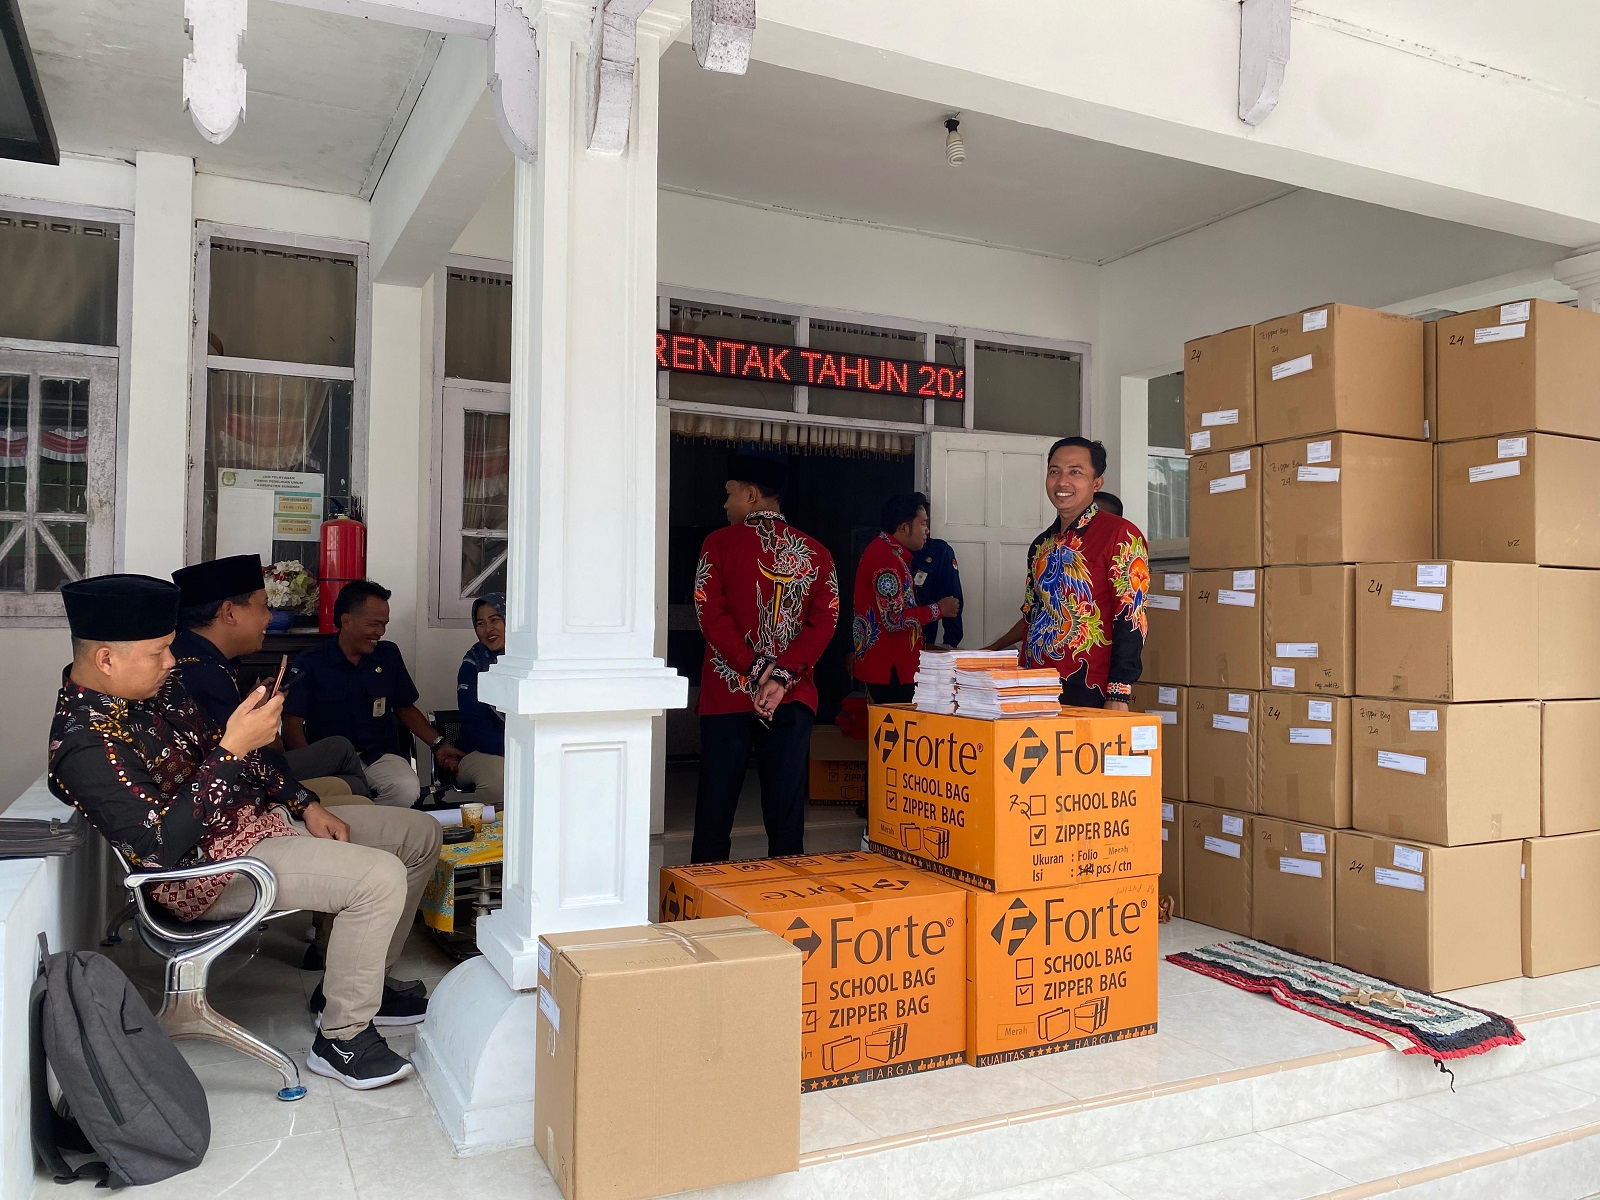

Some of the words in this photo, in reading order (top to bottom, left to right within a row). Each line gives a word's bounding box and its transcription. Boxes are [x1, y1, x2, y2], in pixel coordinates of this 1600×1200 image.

[1449, 334, 1465, 346] 24
[800, 352, 907, 393] TAHUN
[1198, 590, 1211, 603] 24
[1367, 580, 1383, 596] 24
[1268, 706, 1281, 720] 24
[1055, 730, 1149, 777] Fort
[844, 762, 866, 771] SCHO
[844, 774, 866, 782] ZIPPE
[902, 773, 943, 798] SCHOOL
[946, 783, 970, 803] BAG
[1055, 792, 1108, 813] SCHOOL
[1111, 790, 1137, 808] BAG
[902, 796, 937, 822] ZIPPER
[941, 806, 965, 828] BAG
[880, 823, 895, 835] Merah
[1055, 822, 1101, 843] ZIPPER
[1104, 819, 1130, 838] BAG
[1262, 831, 1272, 842] 24
[870, 842, 896, 858] KUALITAS
[925, 862, 957, 878] HARGA
[1032, 854, 1064, 866] Ukuran
[1078, 849, 1098, 862] Folio
[1108, 845, 1129, 856] Merah
[1032, 869, 1044, 882] Isi
[1096, 864, 1111, 878] pcs
[1118, 860, 1132, 872] ctn
[1349, 861, 1364, 874] 24
[1044, 950, 1102, 975] SCHOOL
[1105, 945, 1132, 966] BAG
[829, 972, 900, 1000] SCHOOL
[902, 967, 936, 990] BAG
[1044, 979, 1093, 1001] ZIPPER
[1100, 970, 1128, 992] BAG
[828, 1002, 888, 1028] ZIPPER
[896, 995, 930, 1018] BAG
[1004, 1027, 1028, 1036] Merah
[980, 1050, 1025, 1066] KUALITAS
[1074, 1033, 1114, 1050] HARGA
[866, 1064, 914, 1082] HARGA
